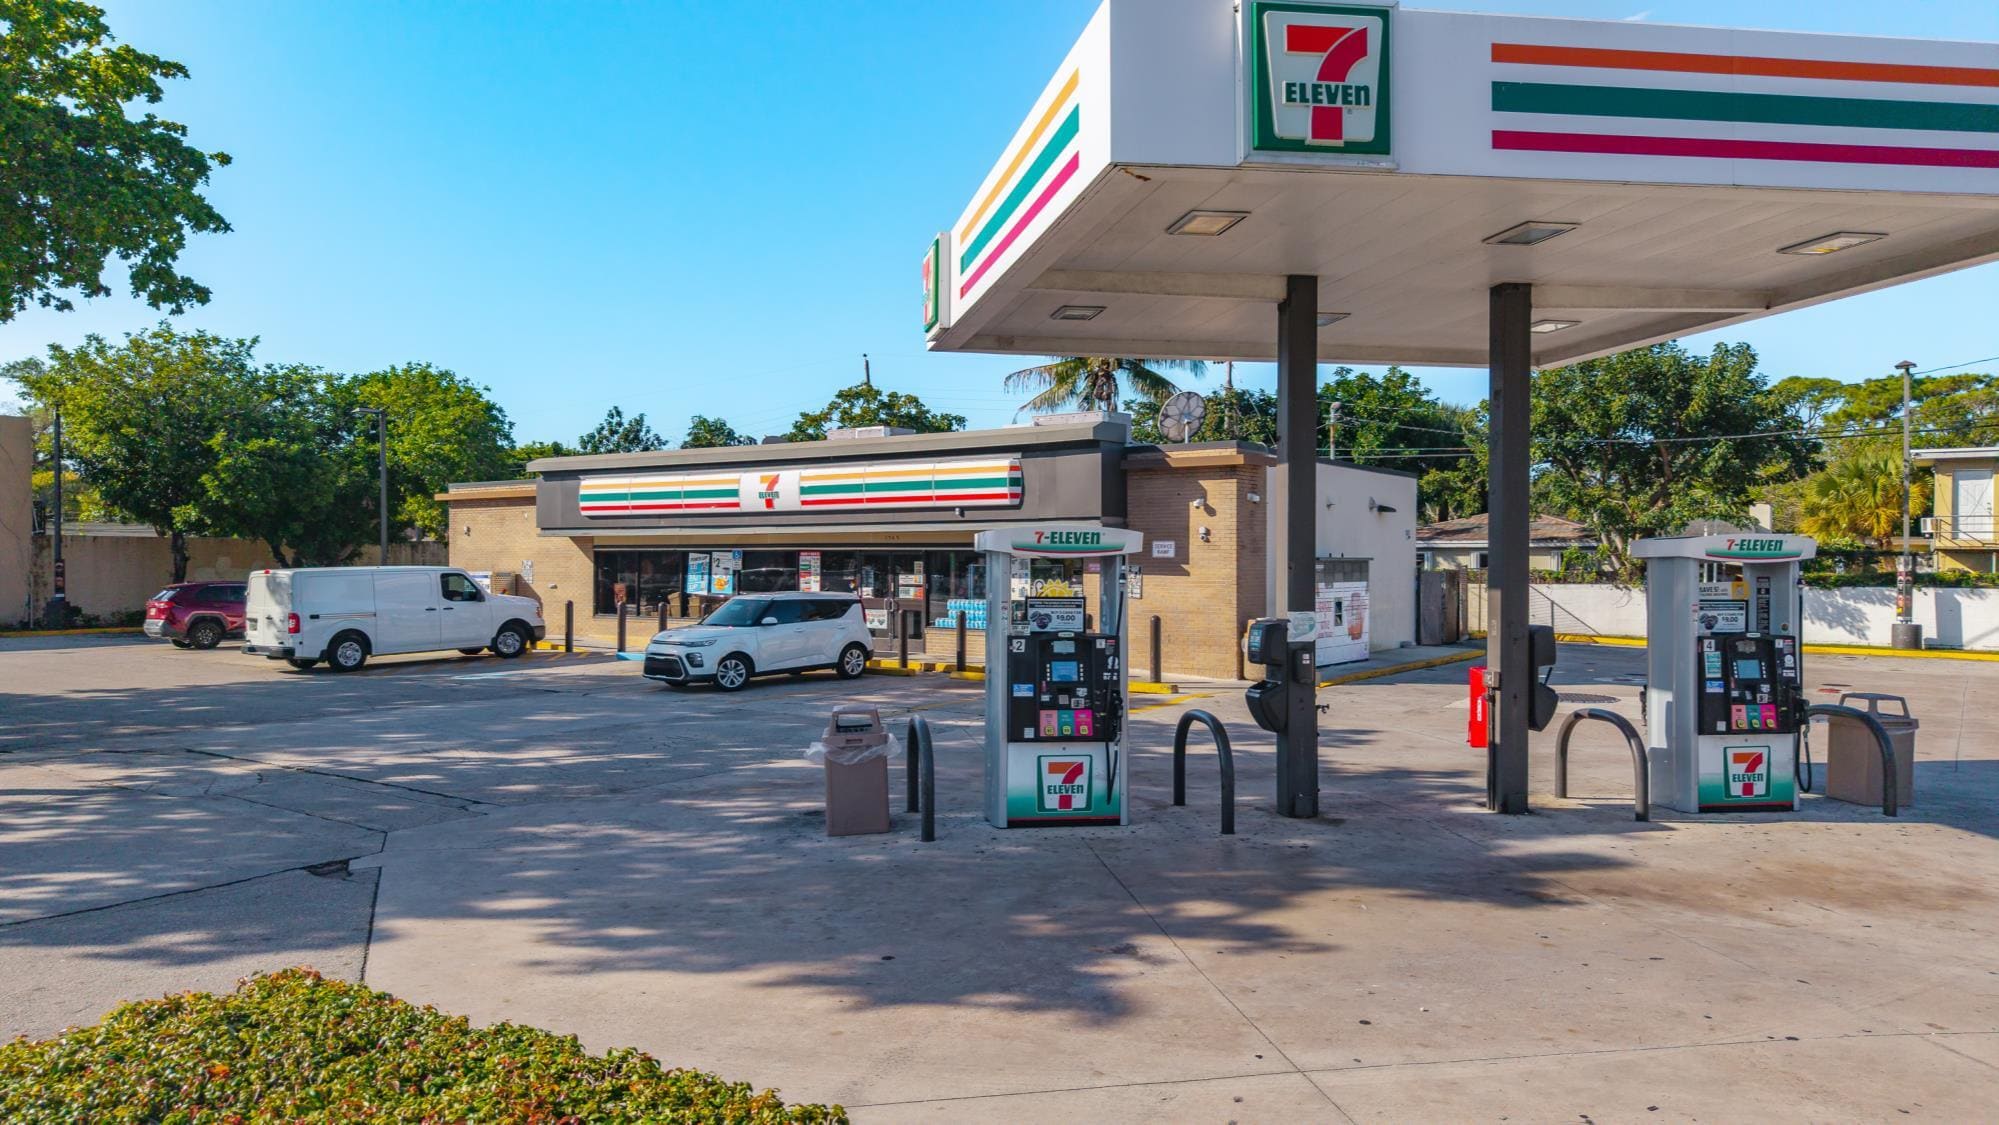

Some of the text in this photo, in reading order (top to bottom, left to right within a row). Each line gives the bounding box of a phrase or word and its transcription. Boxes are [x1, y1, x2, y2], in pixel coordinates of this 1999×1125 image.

[1286, 25, 1368, 140] 7
[760, 474, 779, 508] 7
[1015, 641, 1023, 650] 2
[1706, 641, 1713, 649] 4
[1047, 761, 1084, 809] 7
[1732, 752, 1763, 796] 7
